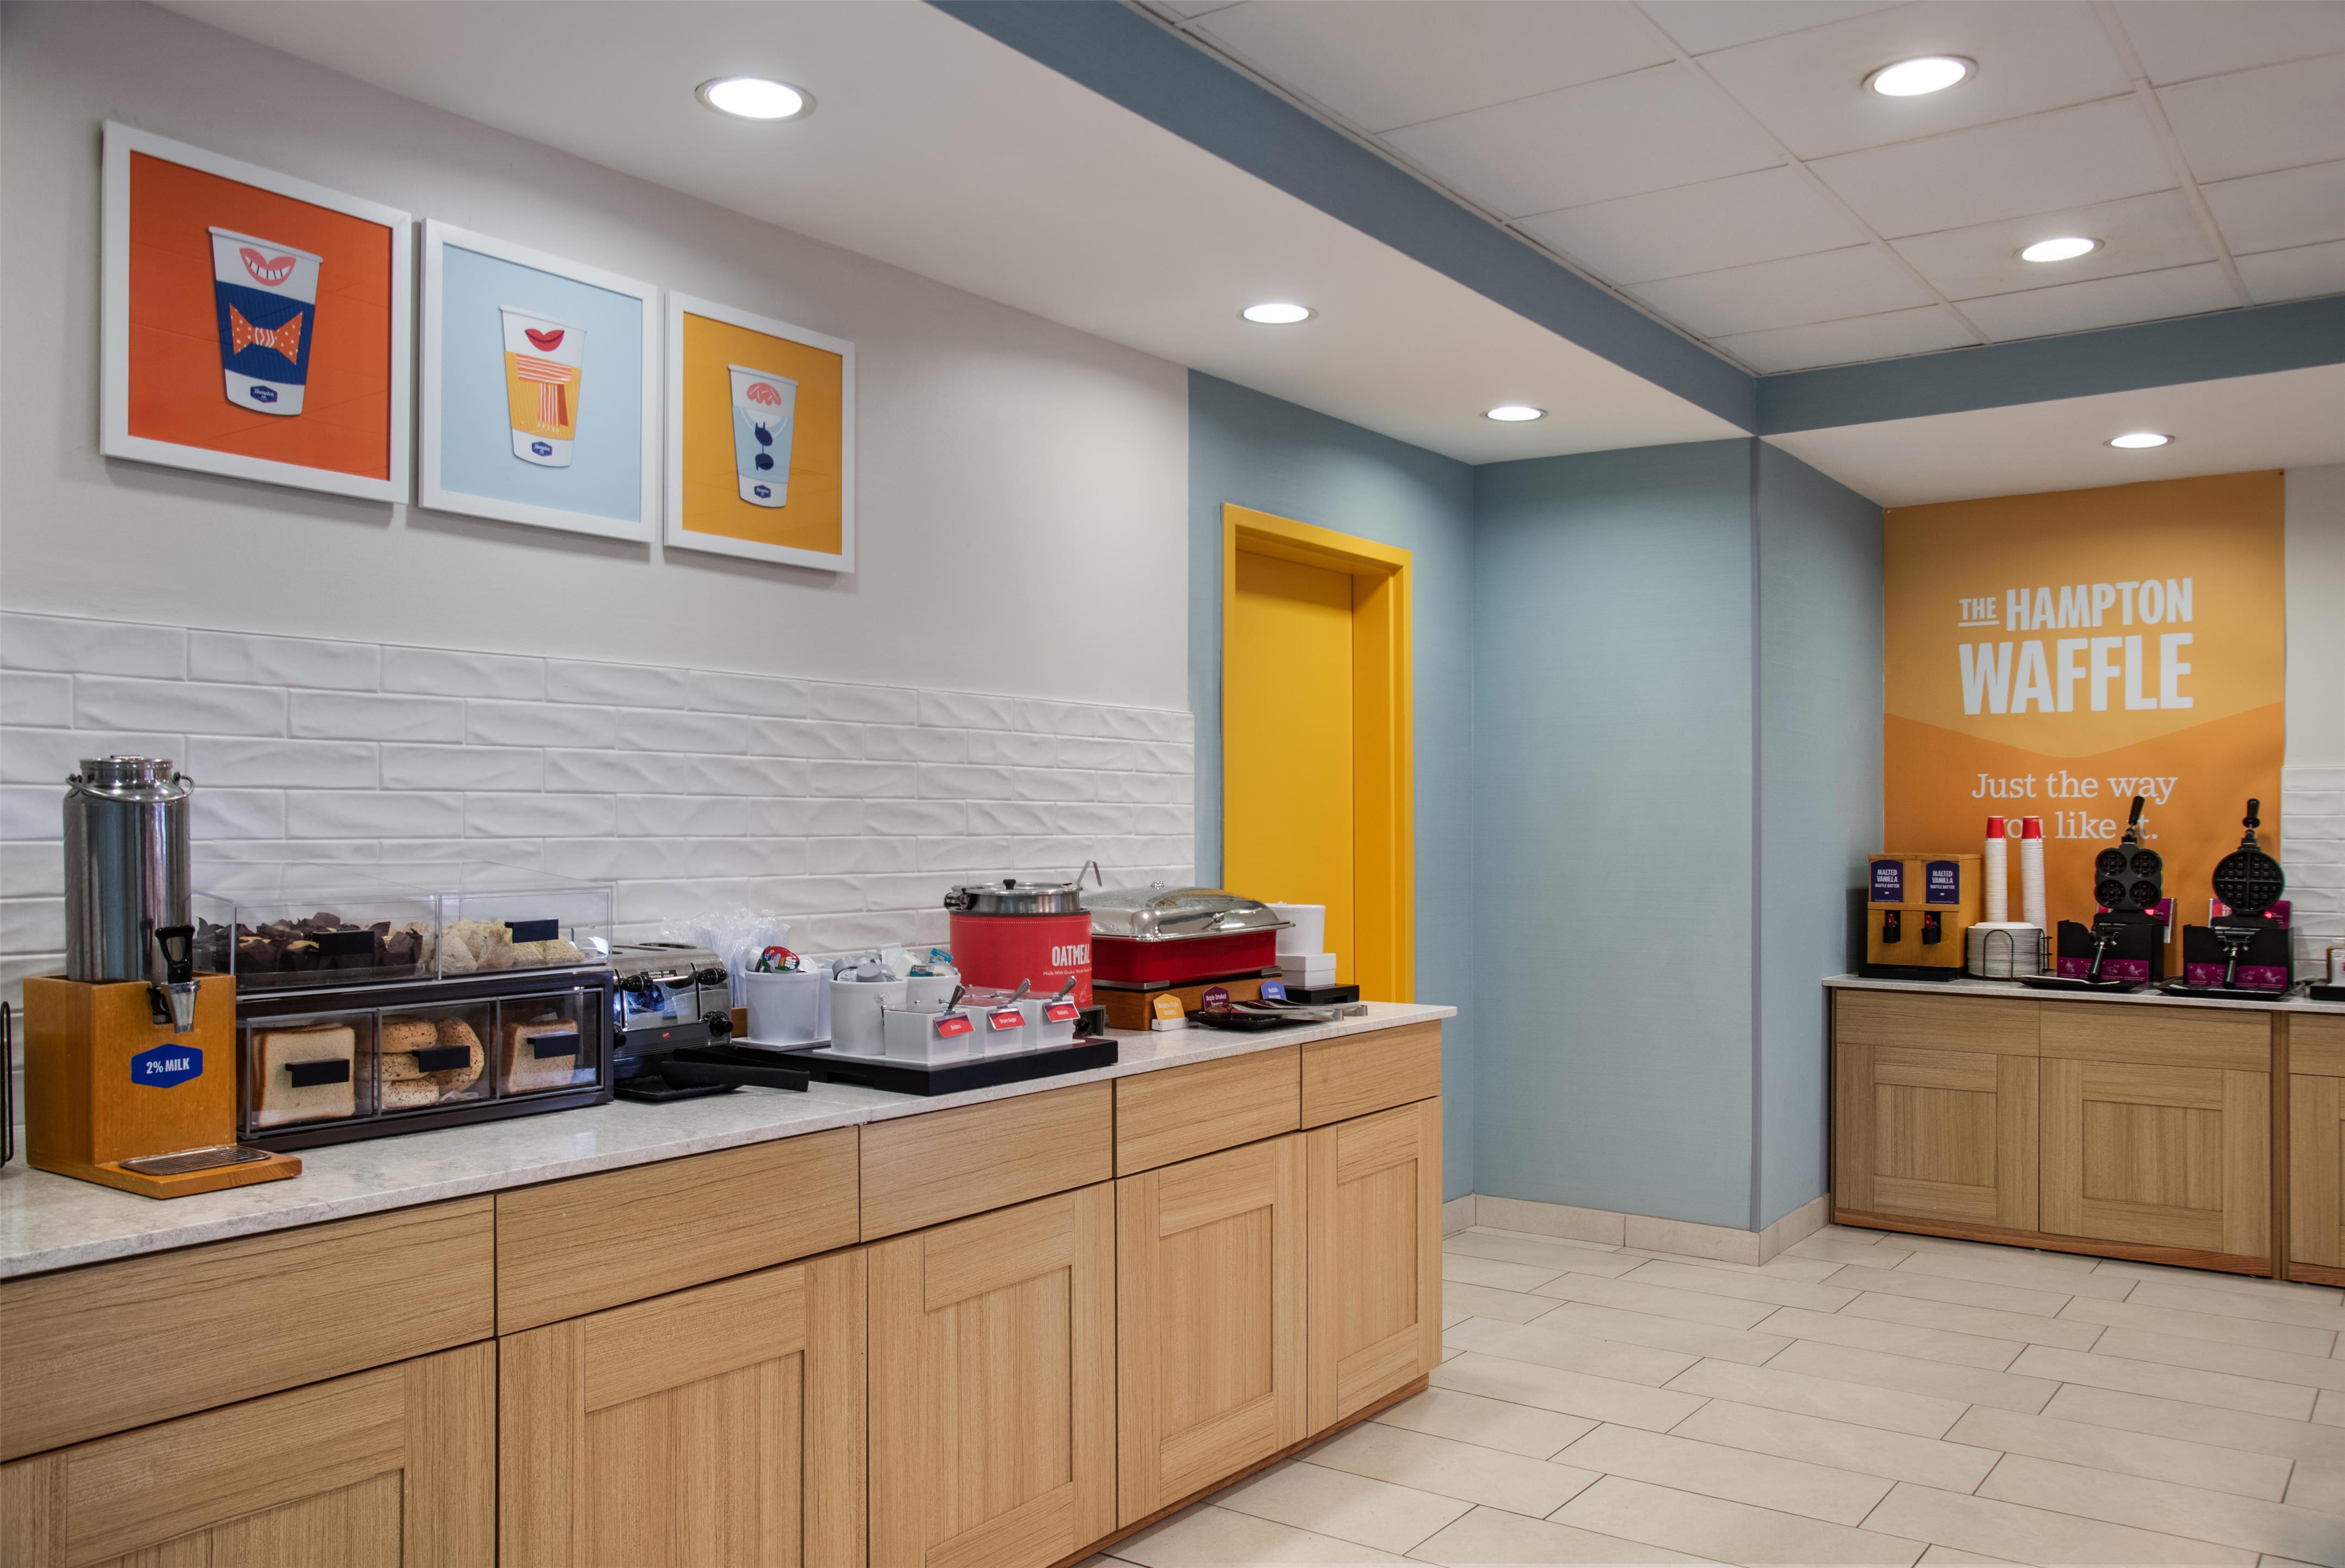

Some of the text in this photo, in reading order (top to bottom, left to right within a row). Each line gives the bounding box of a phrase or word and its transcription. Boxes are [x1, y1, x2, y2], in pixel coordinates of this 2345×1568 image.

[1958, 578, 2194, 631] THE HAMPTON
[1958, 633, 2194, 715] WAFFLE
[1971, 770, 2178, 805] Just the way
[2055, 811, 2117, 839] like
[1051, 943, 1090, 967] OATMEAL
[146, 1057, 190, 1074] 2% MILK
